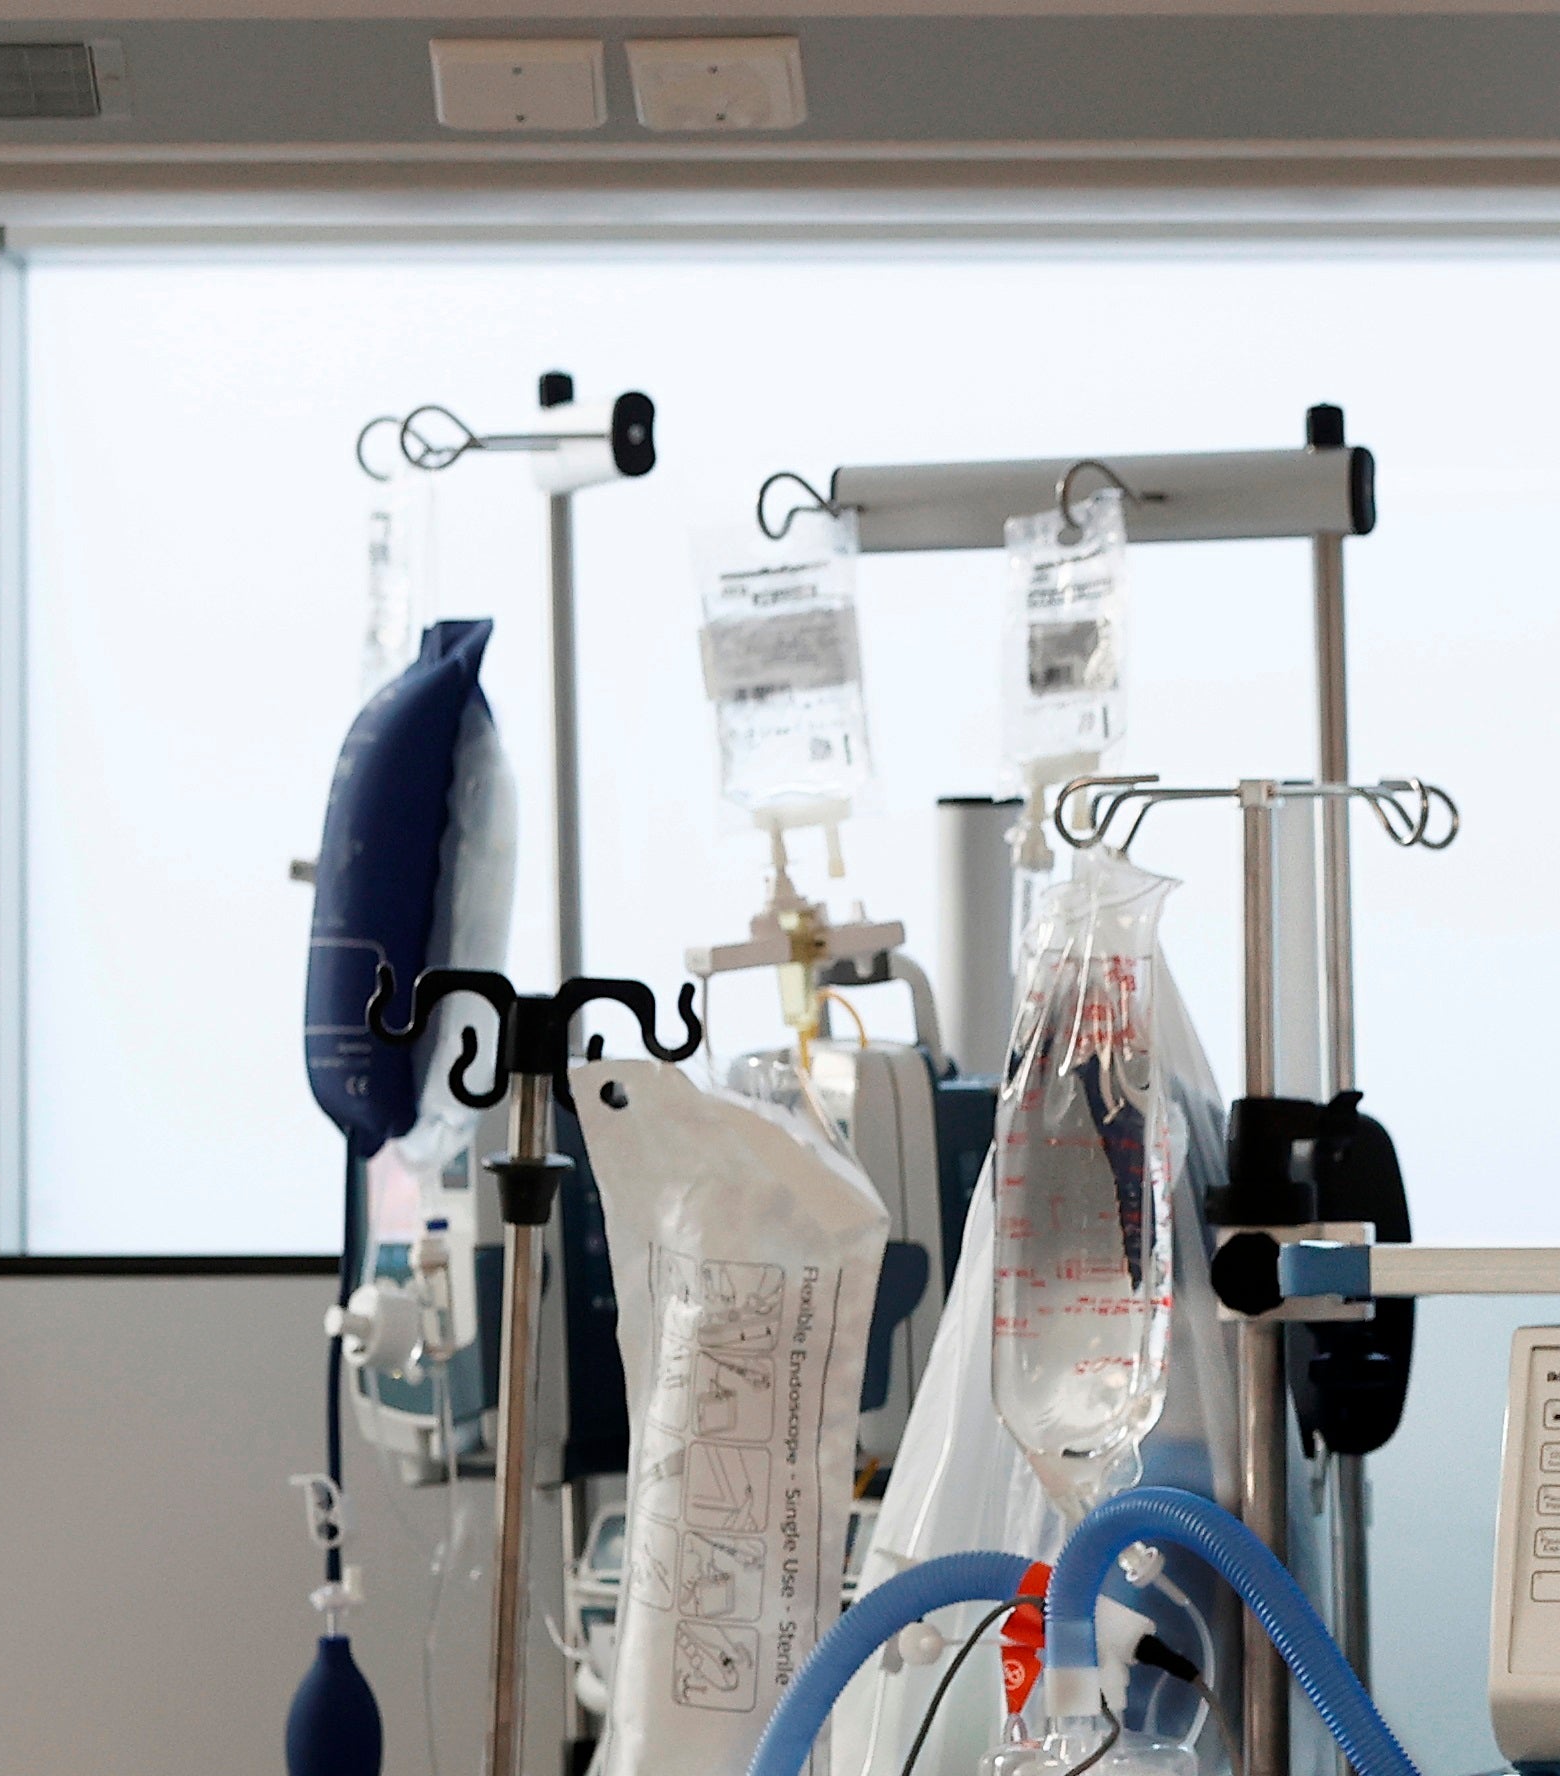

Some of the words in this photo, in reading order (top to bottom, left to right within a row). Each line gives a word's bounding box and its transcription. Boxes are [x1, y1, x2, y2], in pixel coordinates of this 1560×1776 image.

[793, 1265, 819, 1344] Flexible
[784, 1351, 807, 1465] Endoscope
[780, 1488, 801, 1551] Single
[781, 1559, 799, 1597] Use
[775, 1620, 797, 1686] Sterile
